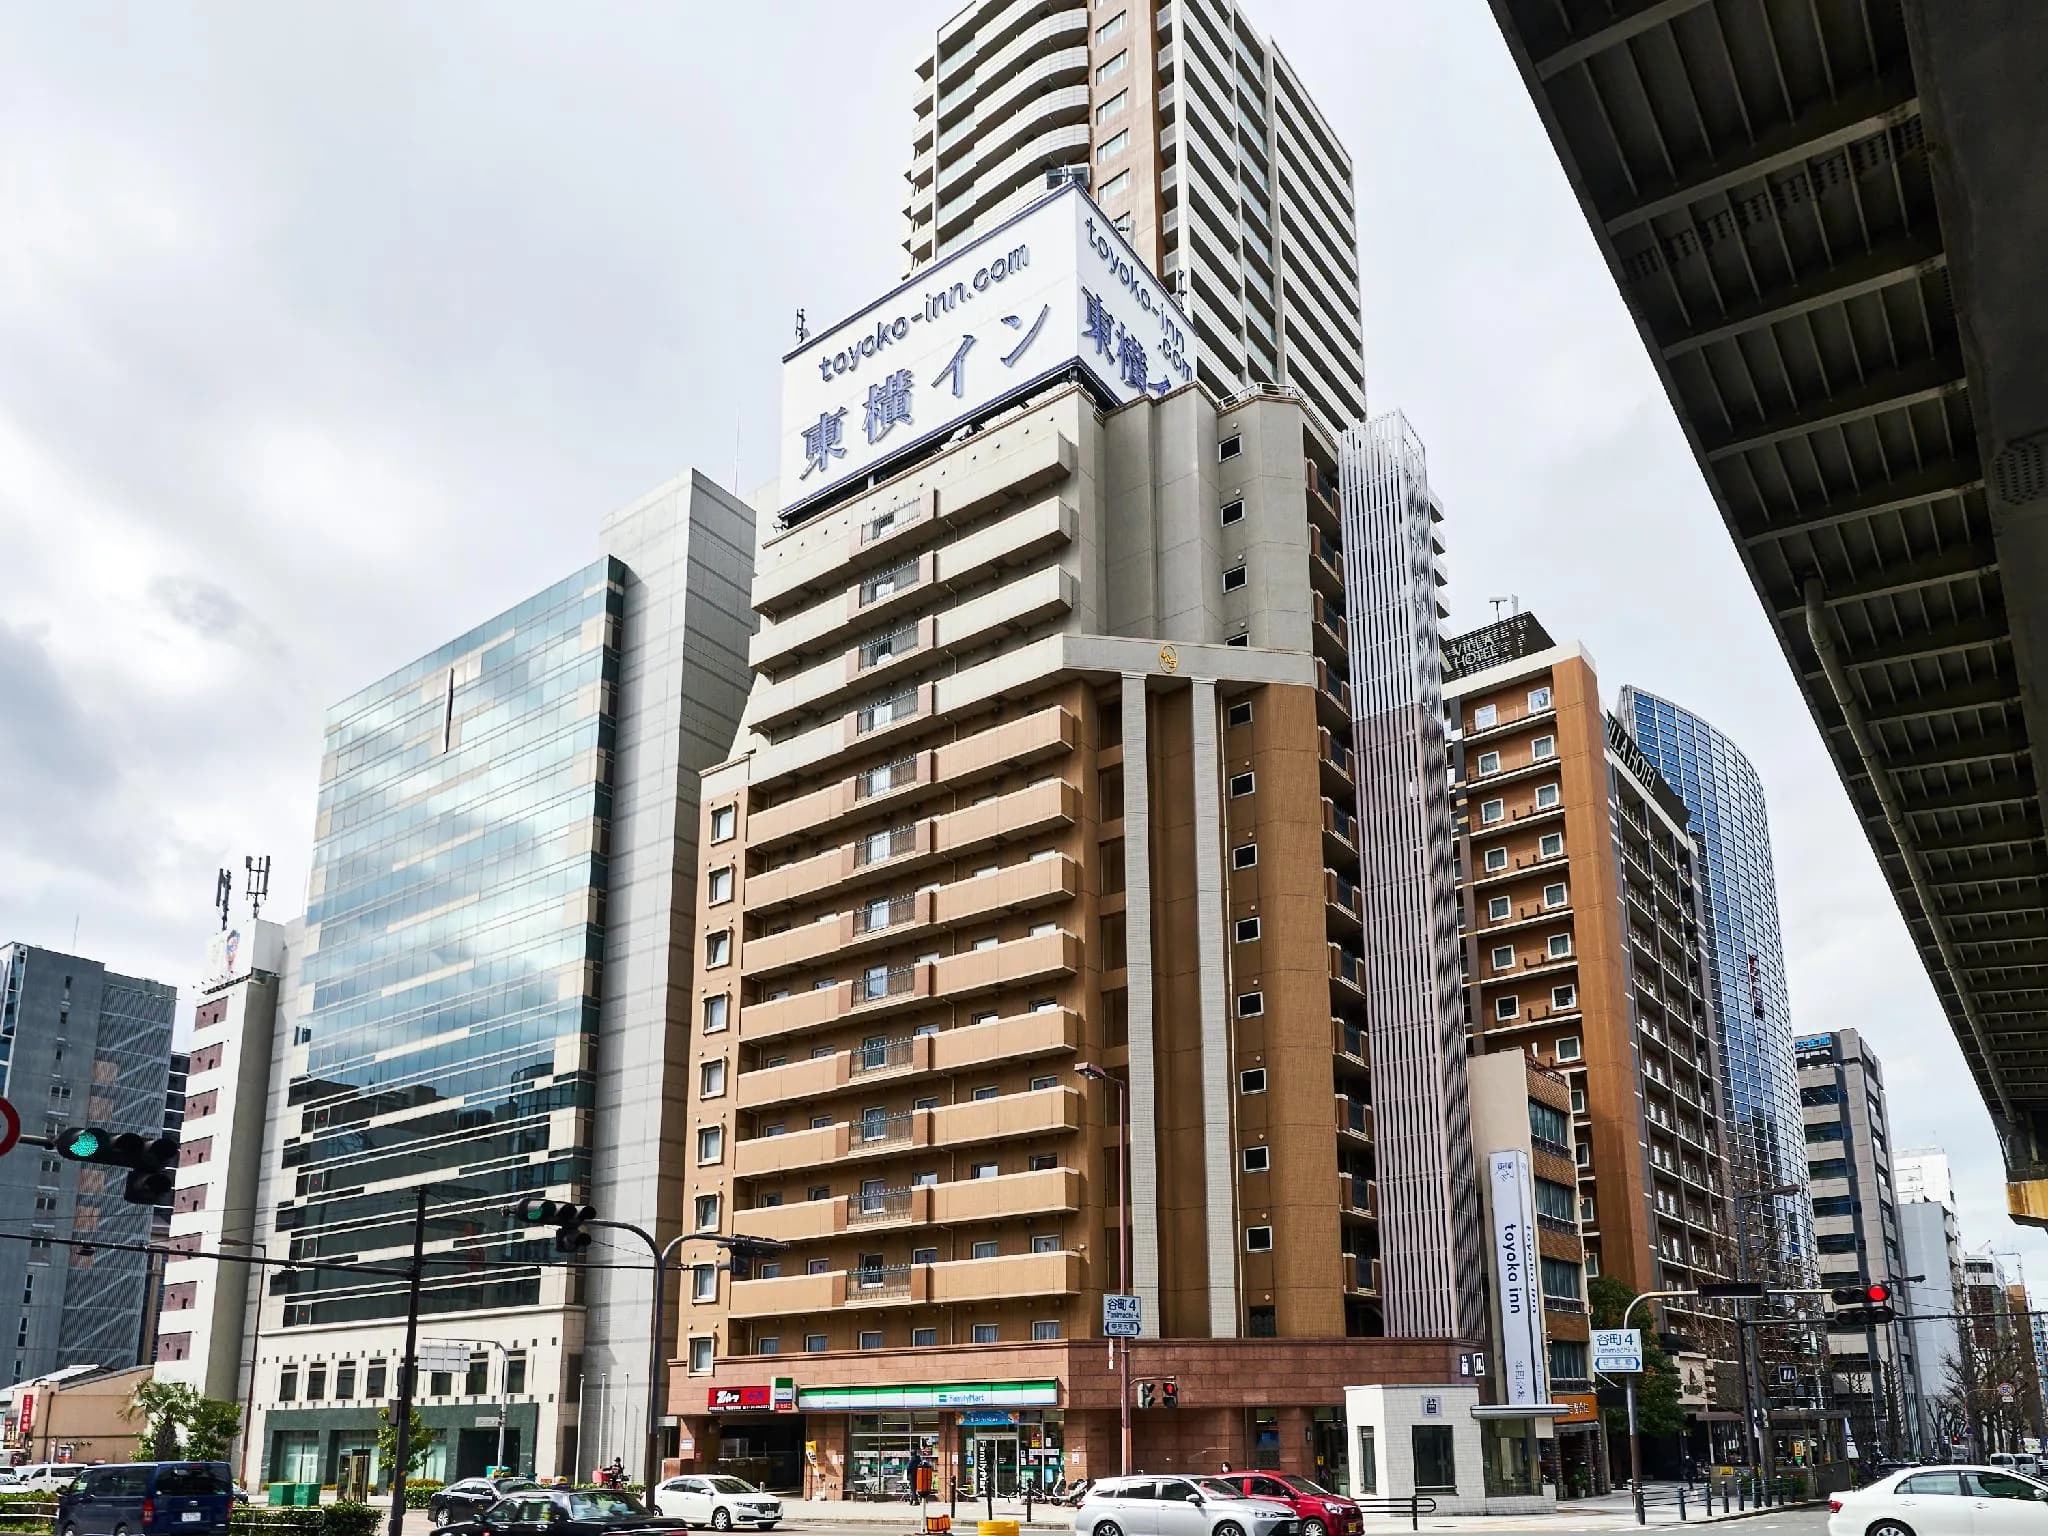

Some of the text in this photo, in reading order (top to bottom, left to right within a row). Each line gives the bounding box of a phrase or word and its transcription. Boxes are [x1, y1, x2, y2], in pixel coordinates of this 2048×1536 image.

[818, 242, 1030, 383] toyoko-inn.com
[1085, 217, 1185, 353] toyoko-inn
[800, 303, 1050, 481] 東横イン
[1157, 338, 1193, 382] .com
[1454, 645, 1499, 669] HOTEL
[1627, 745, 1656, 796] HOTEL
[1503, 1223, 1522, 1314] toyoko inn
[1597, 1333, 1634, 1346] 谷町4
